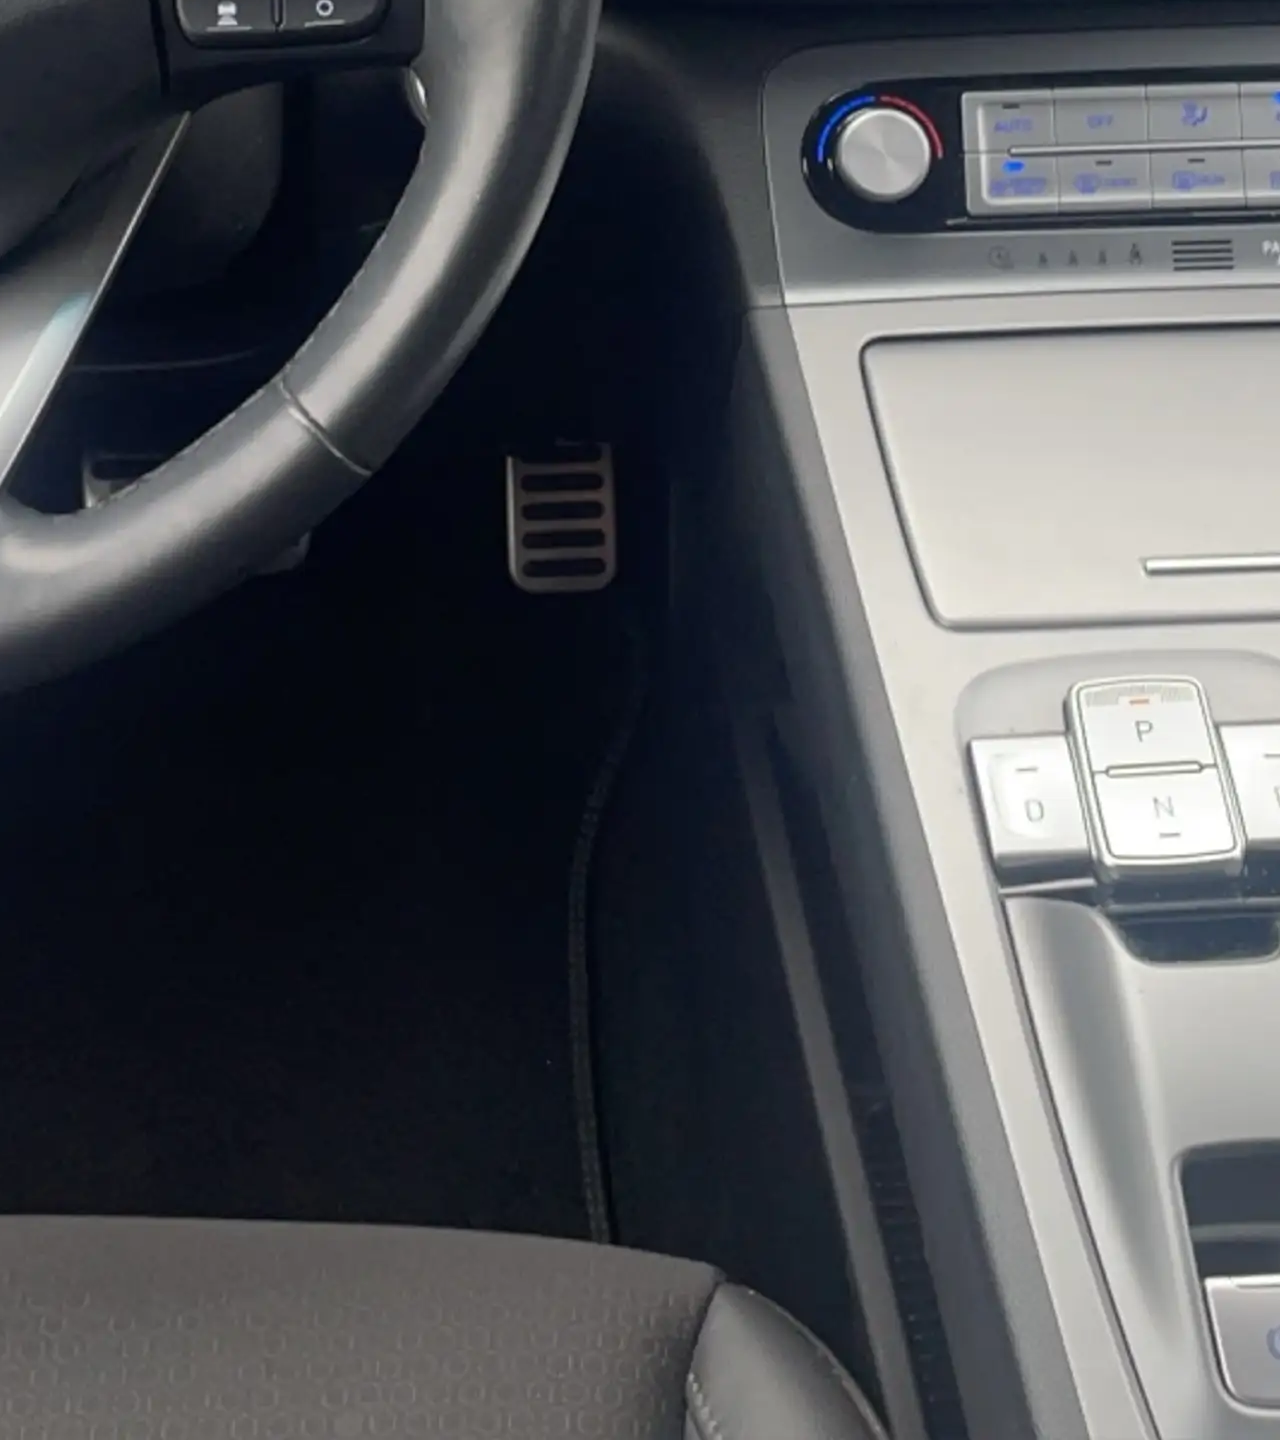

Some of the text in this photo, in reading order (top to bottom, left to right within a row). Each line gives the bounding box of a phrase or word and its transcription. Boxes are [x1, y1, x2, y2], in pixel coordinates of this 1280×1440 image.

[994, 117, 1032, 133] AUTO
[1086, 114, 1114, 130] OFF
[1135, 720, 1154, 742] P
[1152, 796, 1176, 820] N
